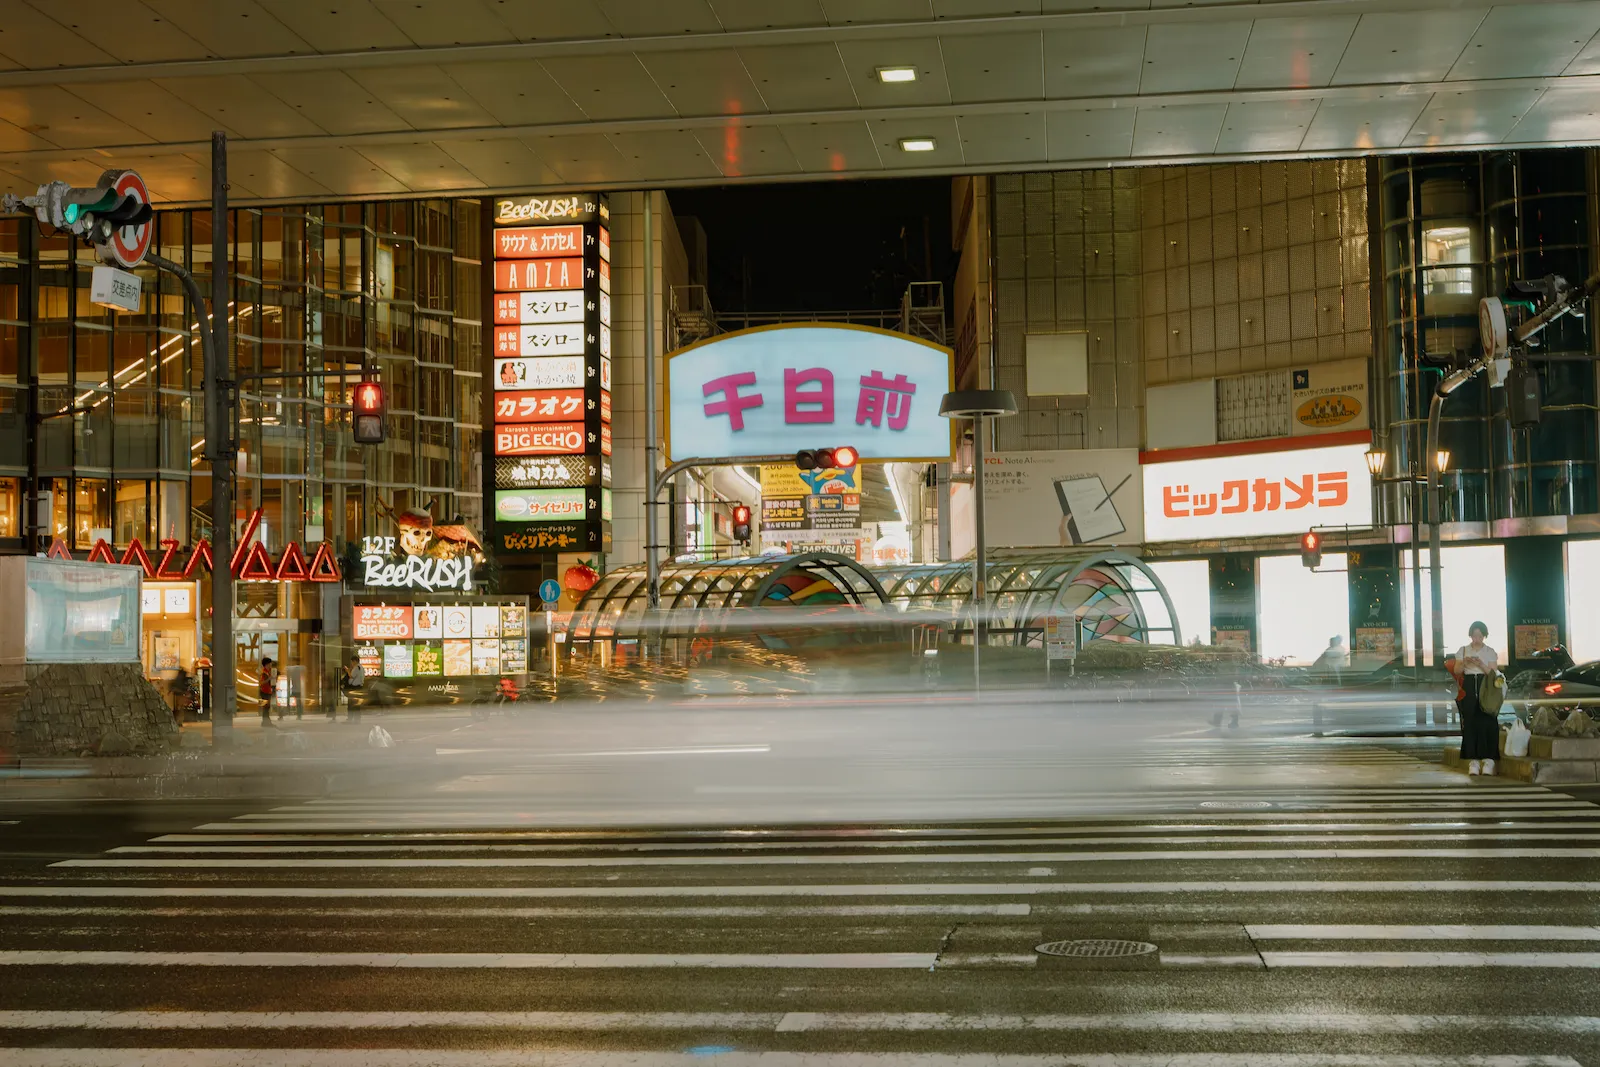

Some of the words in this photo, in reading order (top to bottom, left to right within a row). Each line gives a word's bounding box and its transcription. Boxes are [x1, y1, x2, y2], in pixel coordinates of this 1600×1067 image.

[584, 202, 596, 213] 12F
[501, 234, 528, 252] サウナ
[530, 237, 538, 252] &
[540, 232, 577, 252] カプセル
[586, 235, 595, 246] 7F
[509, 262, 569, 289] AMZA
[586, 268, 595, 278] 7F
[112, 278, 137, 302] 交差点内
[527, 301, 580, 315] スシロー
[587, 301, 595, 311] 4F
[527, 334, 580, 347] スシロー
[587, 333, 595, 344] 4F
[587, 366, 596, 377] 3F
[497, 396, 582, 416] カラオケ
[587, 399, 596, 410] 3F
[702, 367, 917, 432] 千日前
[498, 433, 530, 452] BIG
[533, 432, 582, 449] ECHO
[587, 432, 596, 443] 3F
[1005, 457, 1023, 465] Note
[588, 466, 597, 477] 2F
[1163, 471, 1349, 518] ビックカメラ
[529, 501, 583, 516] サイゼリヤ
[588, 499, 597, 509] 2F
[362, 535, 395, 555] 12F
[504, 532, 577, 550] びっくりドンキー
[360, 555, 473, 592] BeeRUSH
[361, 608, 404, 619] カラオケ
[357, 624, 378, 637] BIG
[379, 624, 408, 636] ECHO
